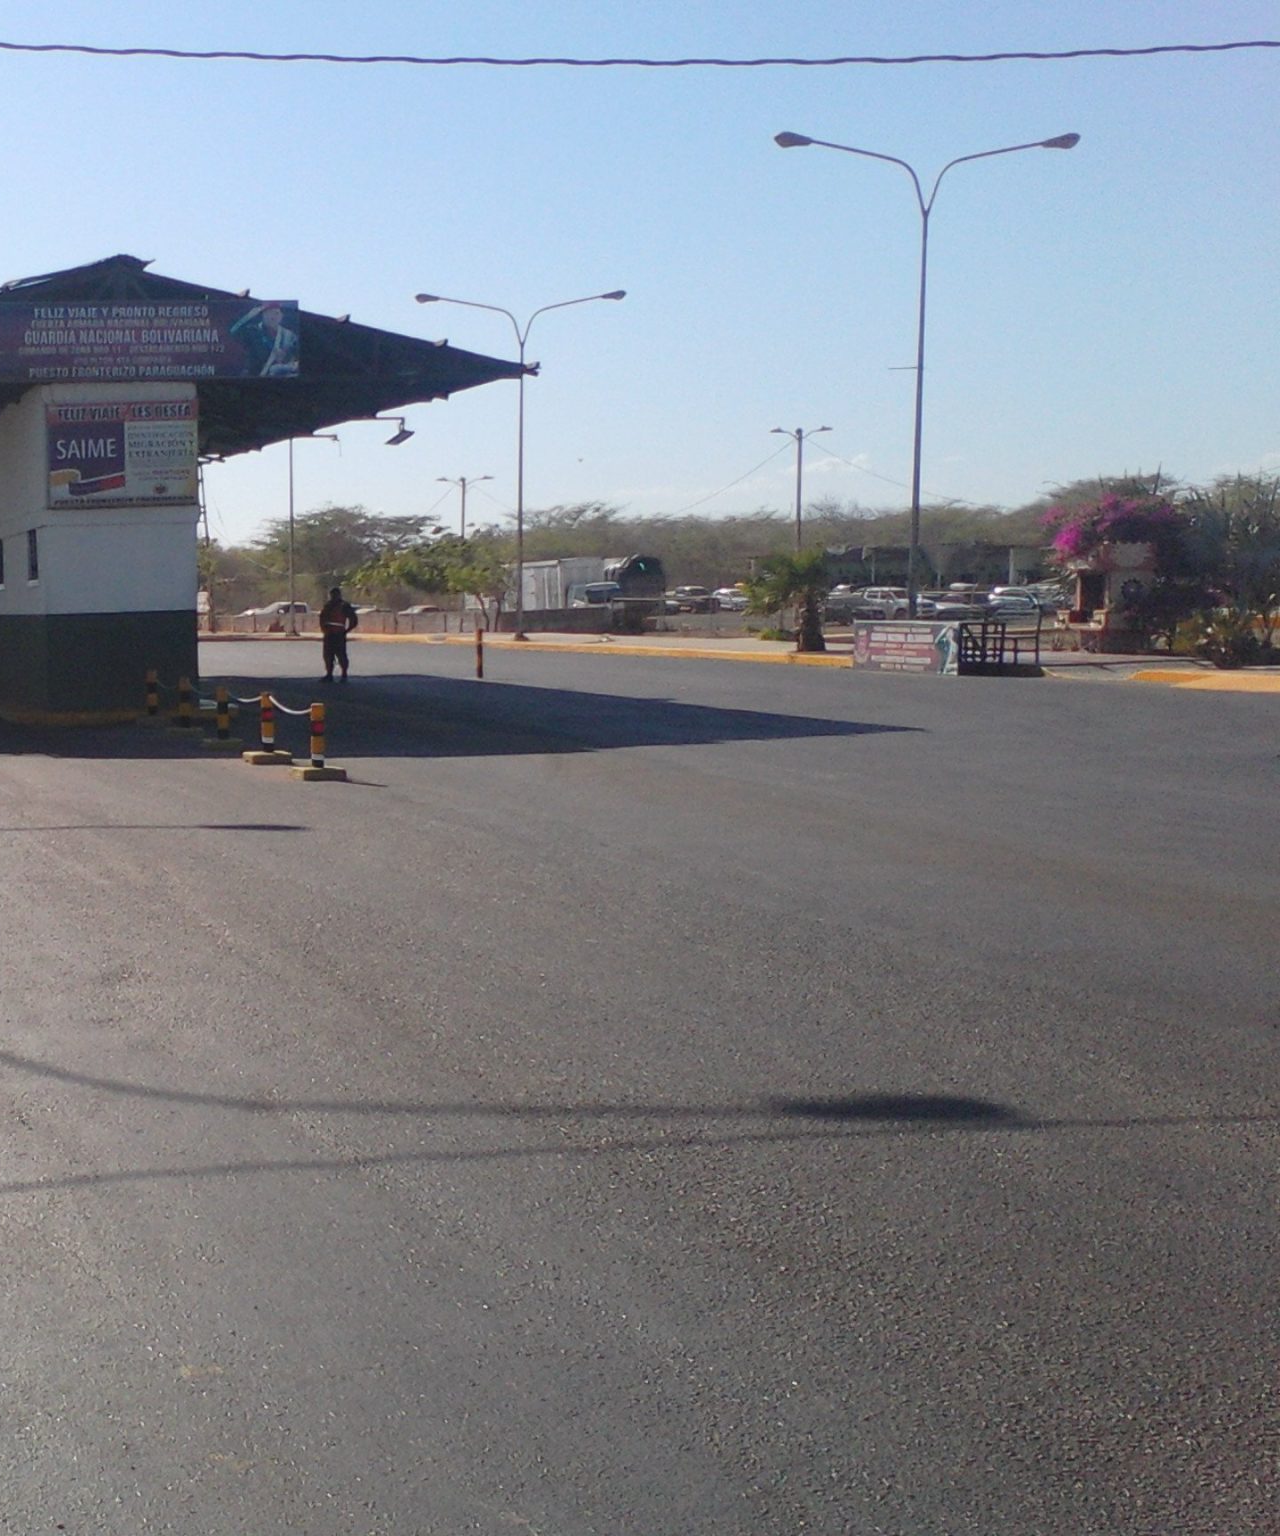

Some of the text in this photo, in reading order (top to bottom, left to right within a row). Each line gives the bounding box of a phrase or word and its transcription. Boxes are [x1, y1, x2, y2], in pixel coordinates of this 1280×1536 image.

[34, 306, 209, 319] FELIZ VIAJE Y PRONTO REGRESO
[24, 329, 219, 345] GUARDIA NACIONAL BOLIVARIANA
[72, 366, 136, 378] FRONTERIZO
[58, 404, 192, 420] FELIZ VIAJE LES DESEA
[56, 438, 117, 460] SAIME
[188, 439, 194, 447] Y
